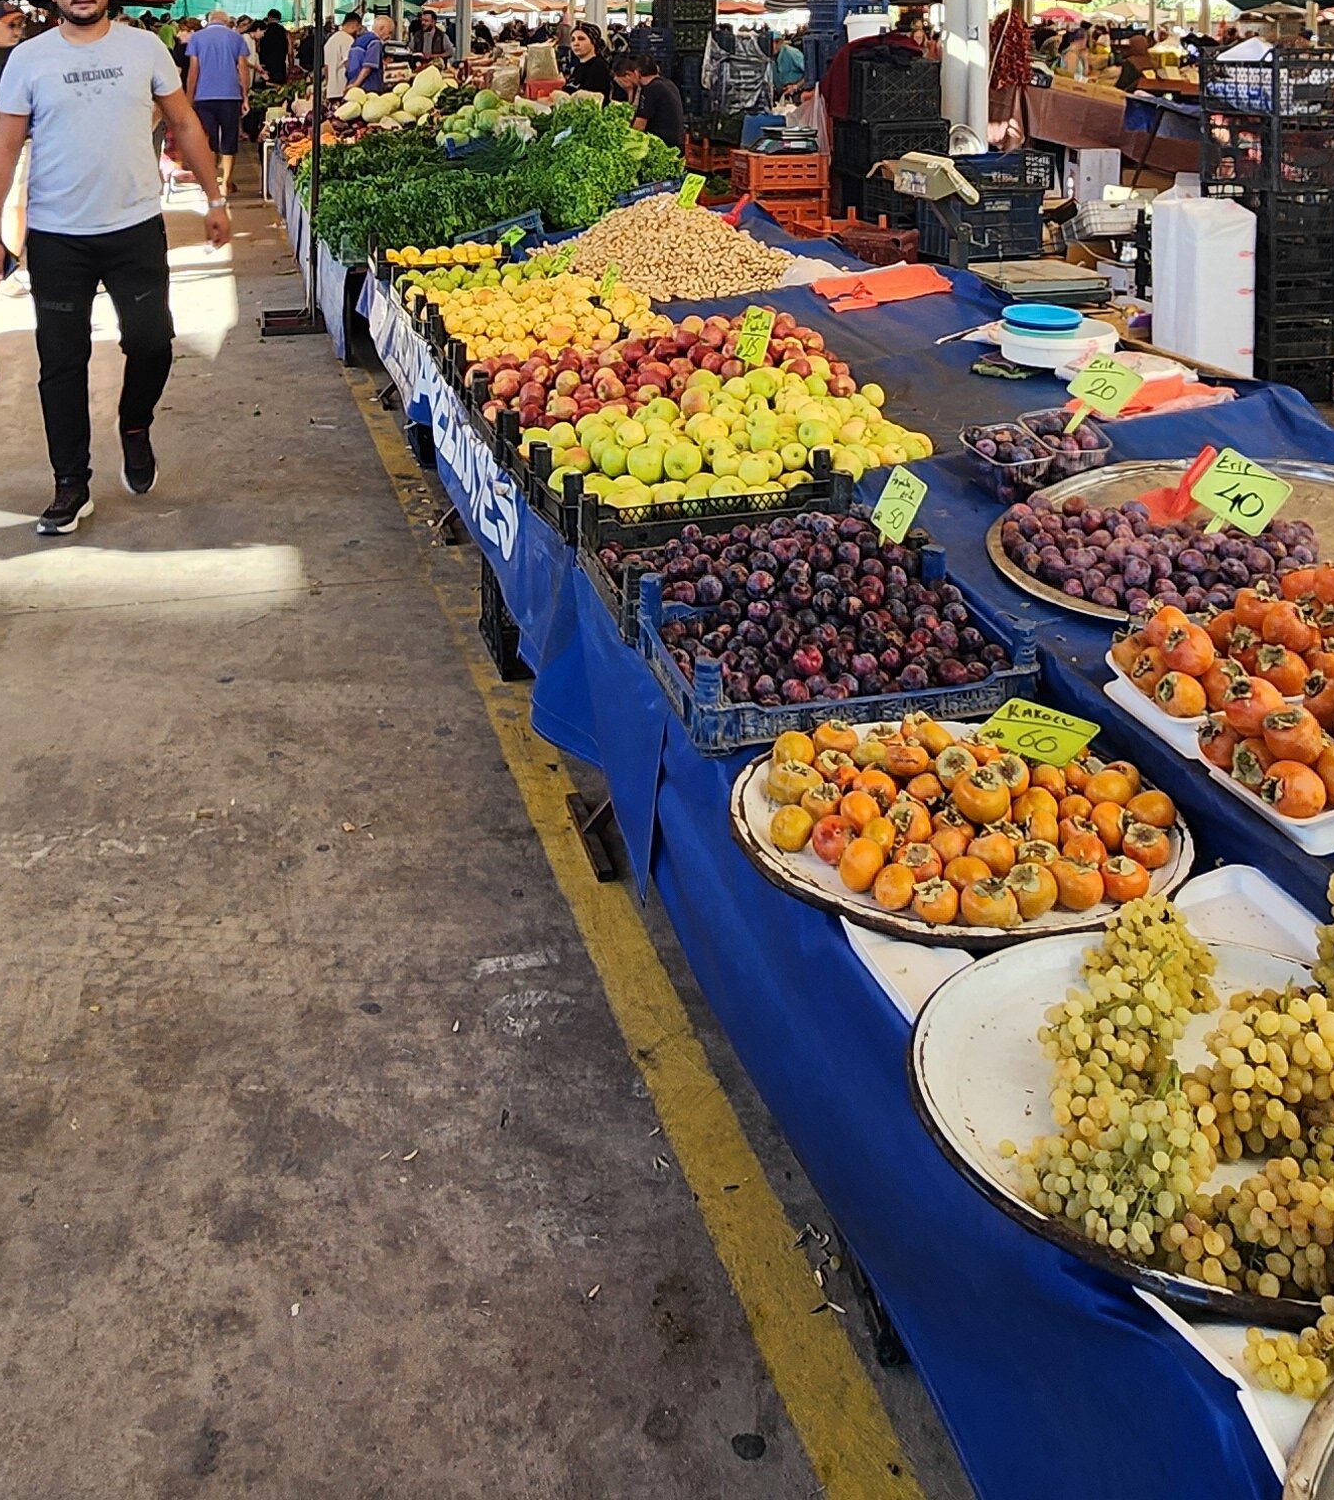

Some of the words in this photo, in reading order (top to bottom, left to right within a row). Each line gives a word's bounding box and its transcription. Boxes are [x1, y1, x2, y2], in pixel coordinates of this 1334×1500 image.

[1084, 377, 1118, 401] 20
[1213, 482, 1265, 518] 40
[886, 507, 905, 530] 50
[1017, 729, 1059, 754] 60
